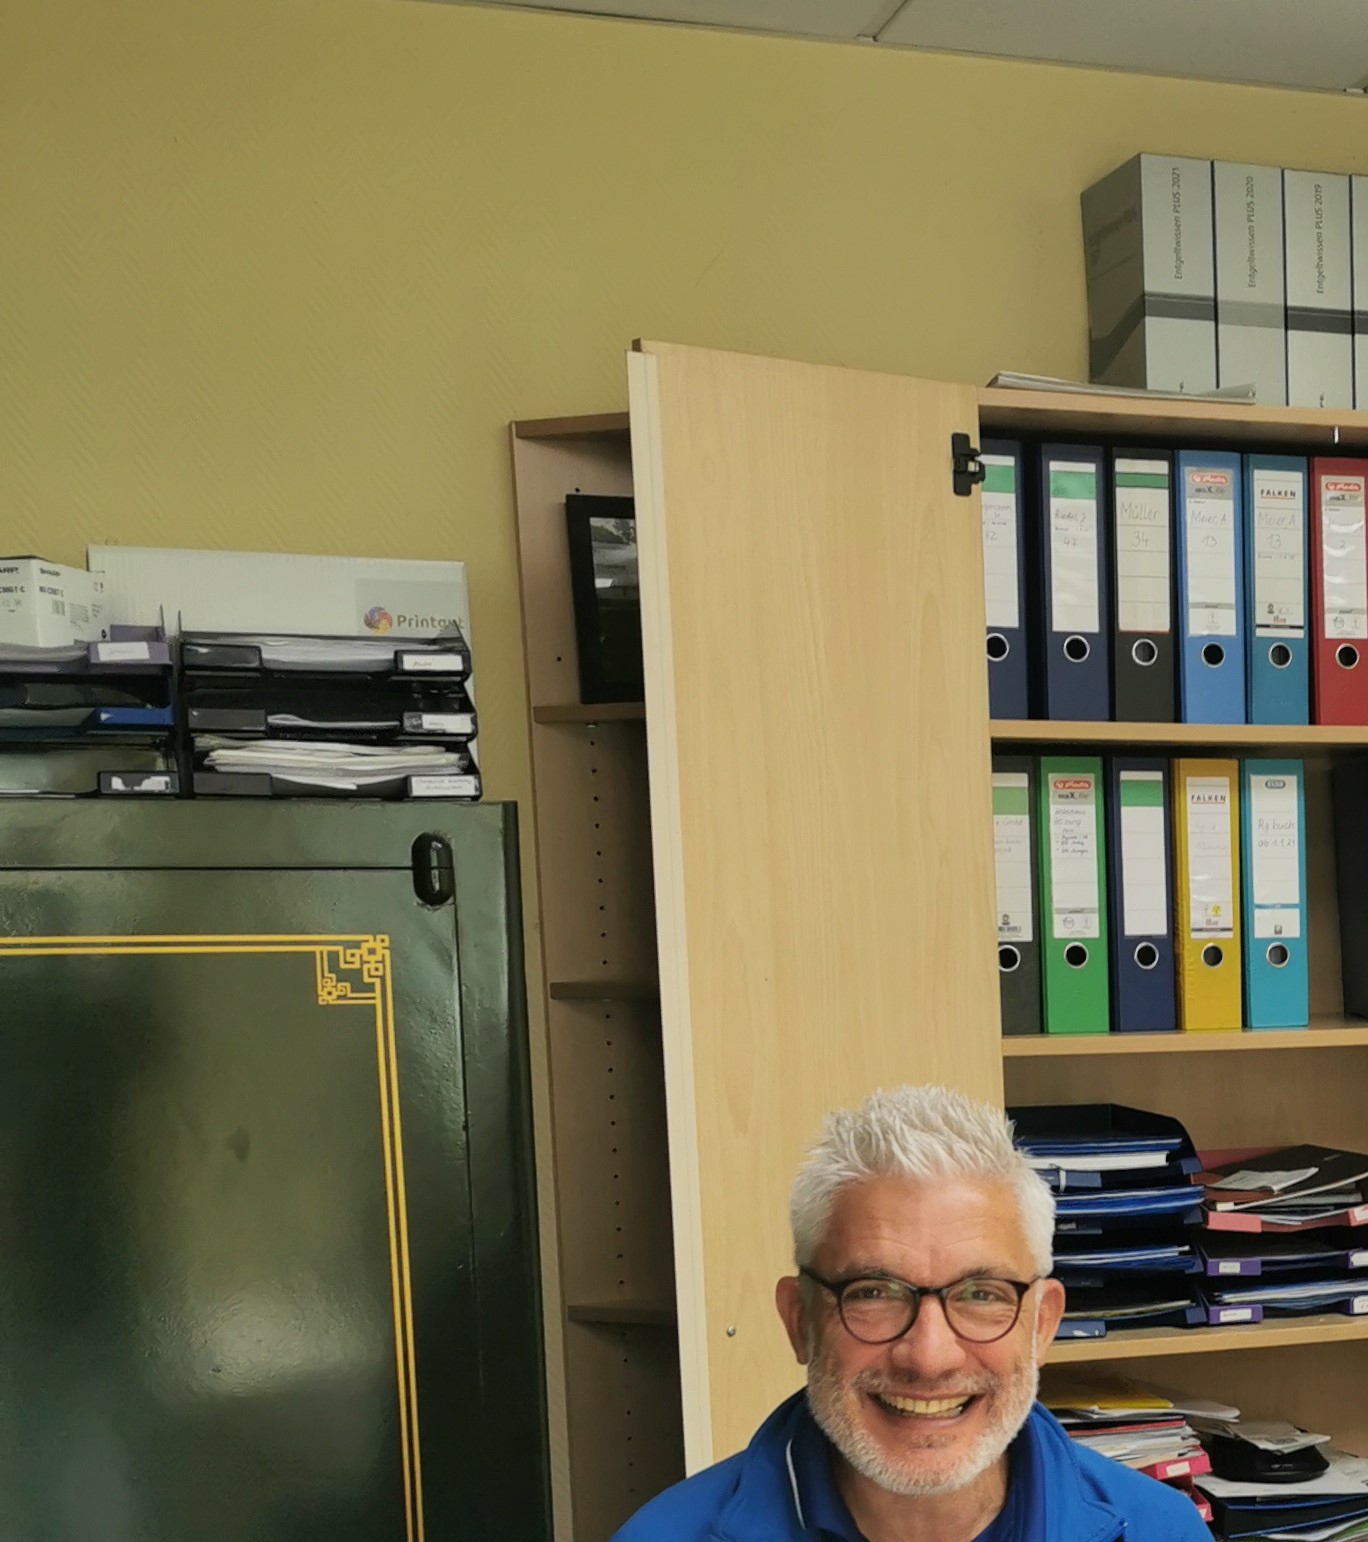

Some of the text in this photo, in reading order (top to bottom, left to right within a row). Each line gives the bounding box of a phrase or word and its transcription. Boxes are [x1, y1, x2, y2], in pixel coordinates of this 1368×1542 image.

[1172, 167, 1184, 280] Entgeltwissen PLUS 2021
[1246, 176, 1258, 288] Entgeltwissen PLUS 2020
[1314, 184, 1325, 294] Entgeltwissen PLUS 2019
[1260, 488, 1296, 497] FALKEN
[1191, 794, 1226, 802] FALKEN
